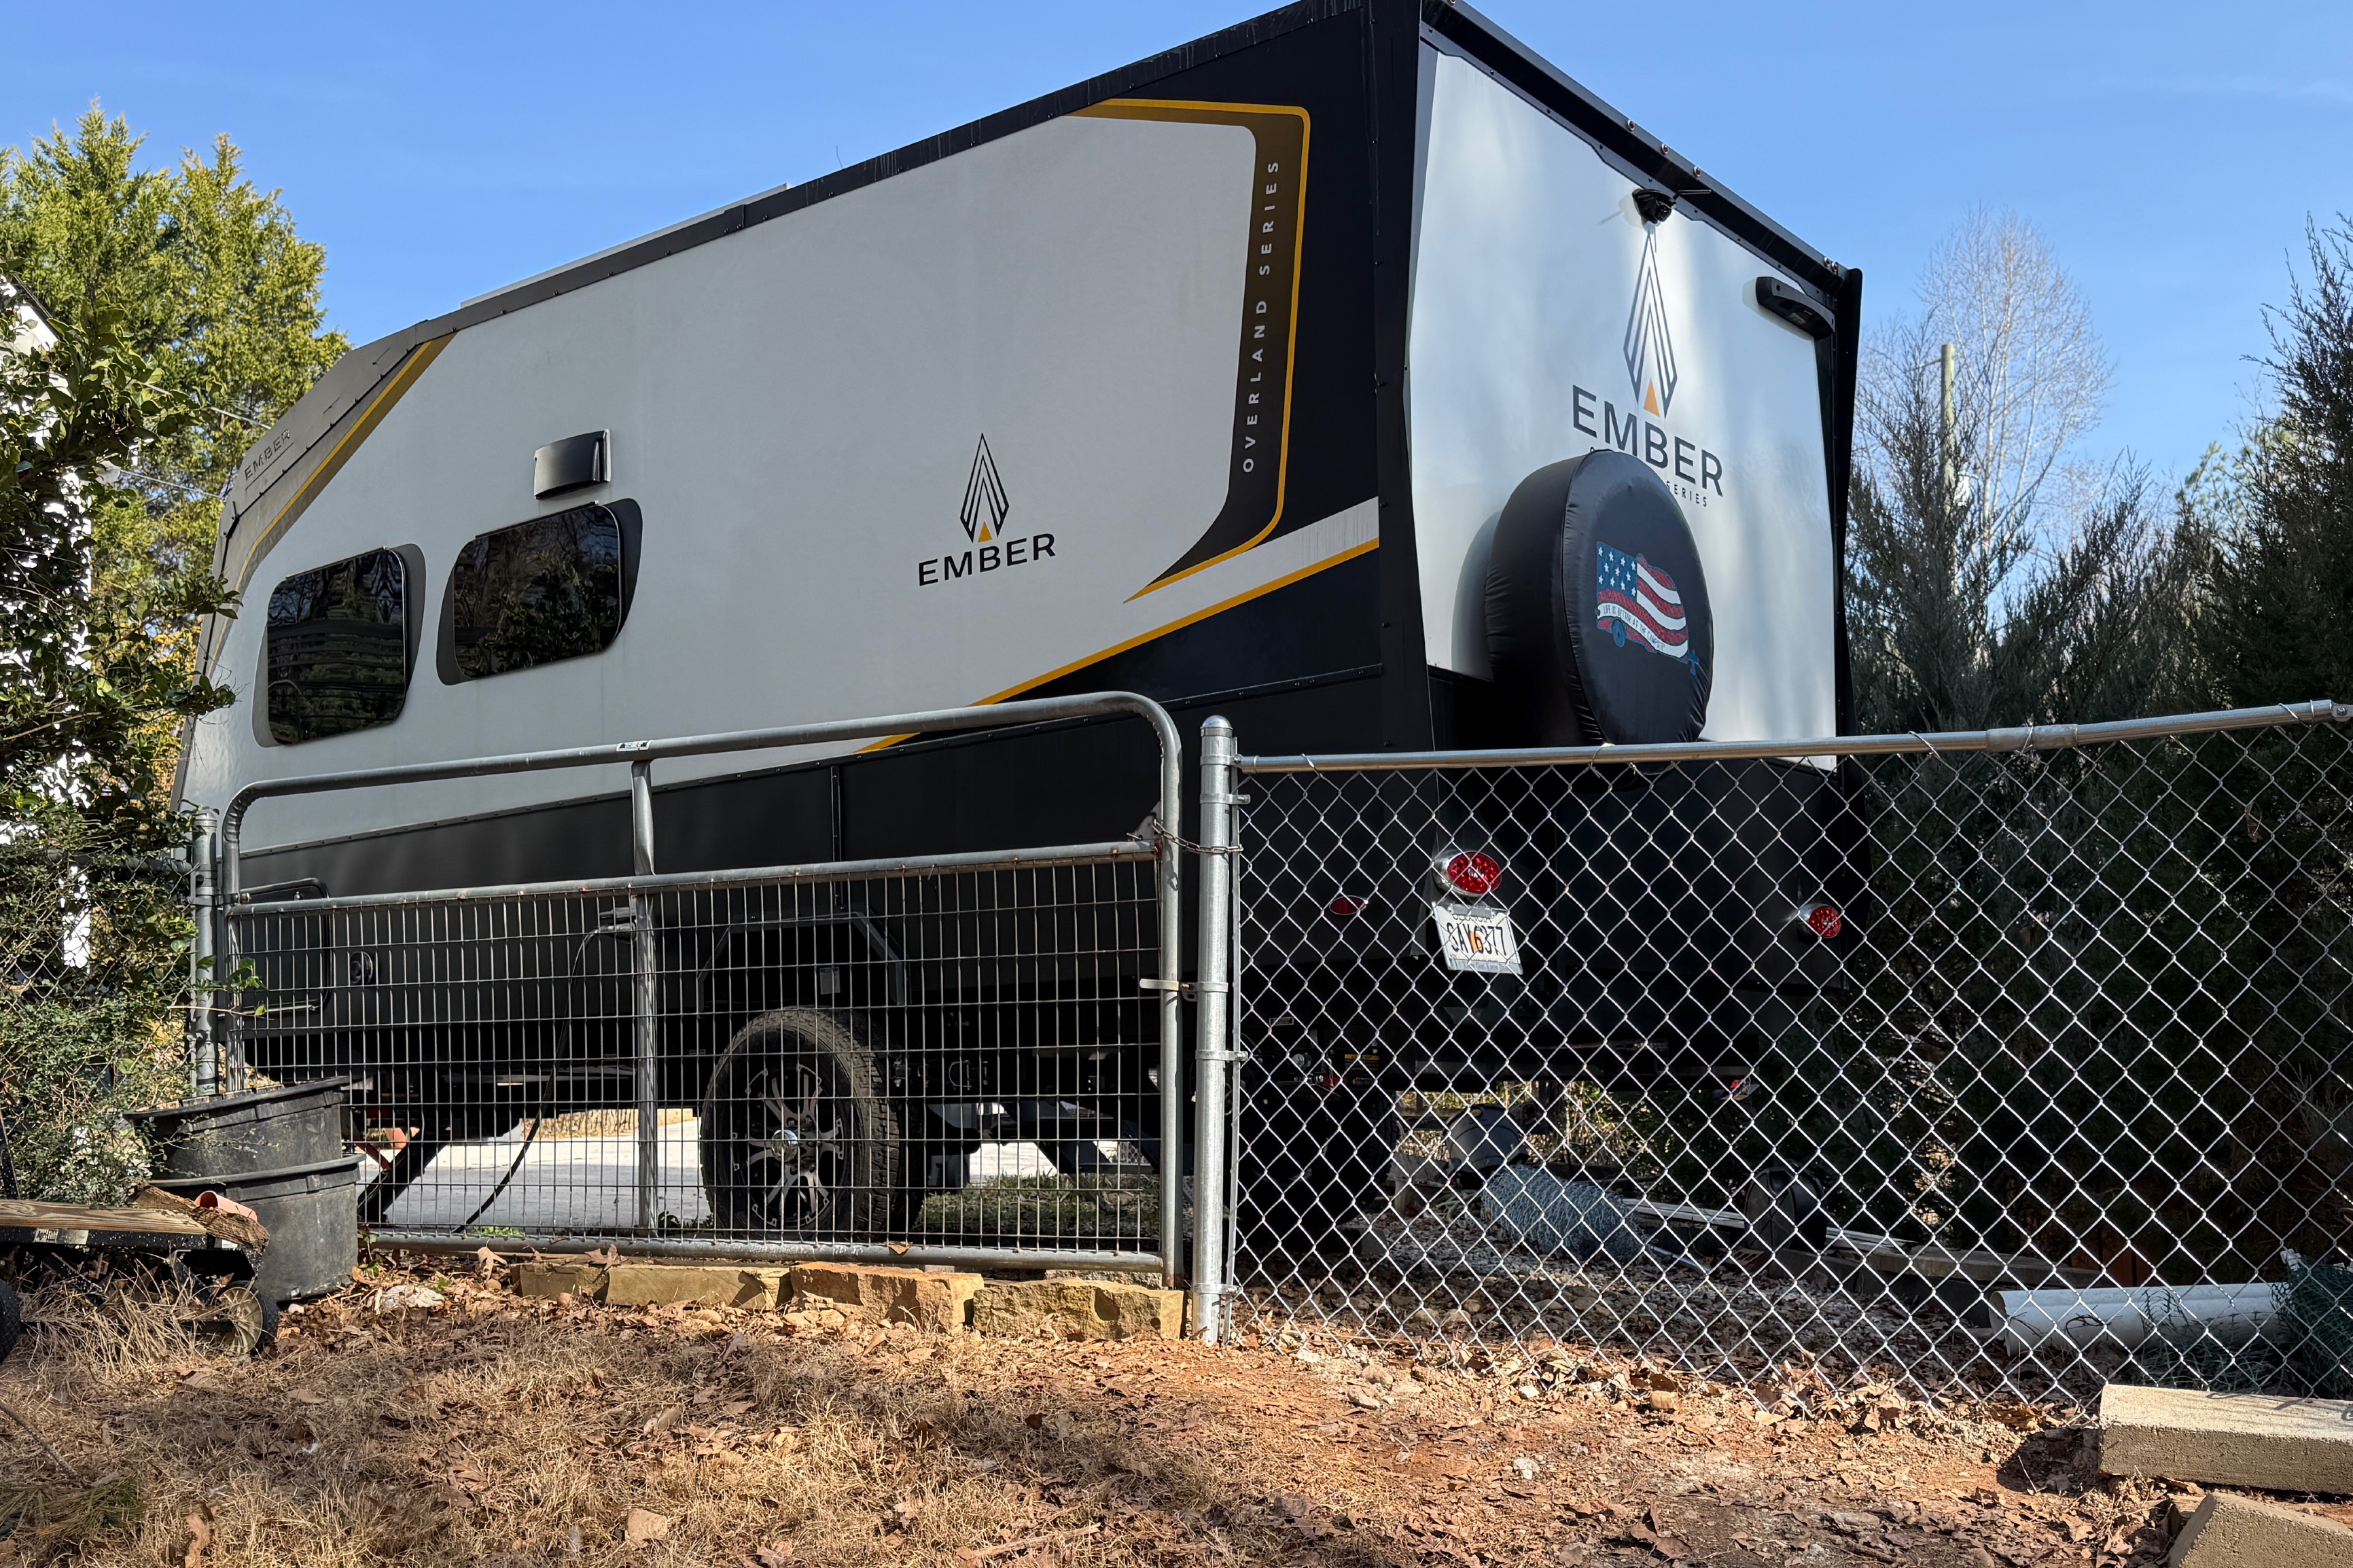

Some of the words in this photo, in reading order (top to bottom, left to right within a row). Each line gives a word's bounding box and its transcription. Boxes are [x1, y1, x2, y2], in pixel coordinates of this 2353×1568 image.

[1243, 300, 1267, 473] OVERLAND
[1259, 162, 1279, 275] SERIES
[245, 429, 291, 480] EMBER
[1572, 385, 1723, 497] EMBER
[919, 533, 1056, 586] EMBER
[1633, 618, 1638, 628] AT
